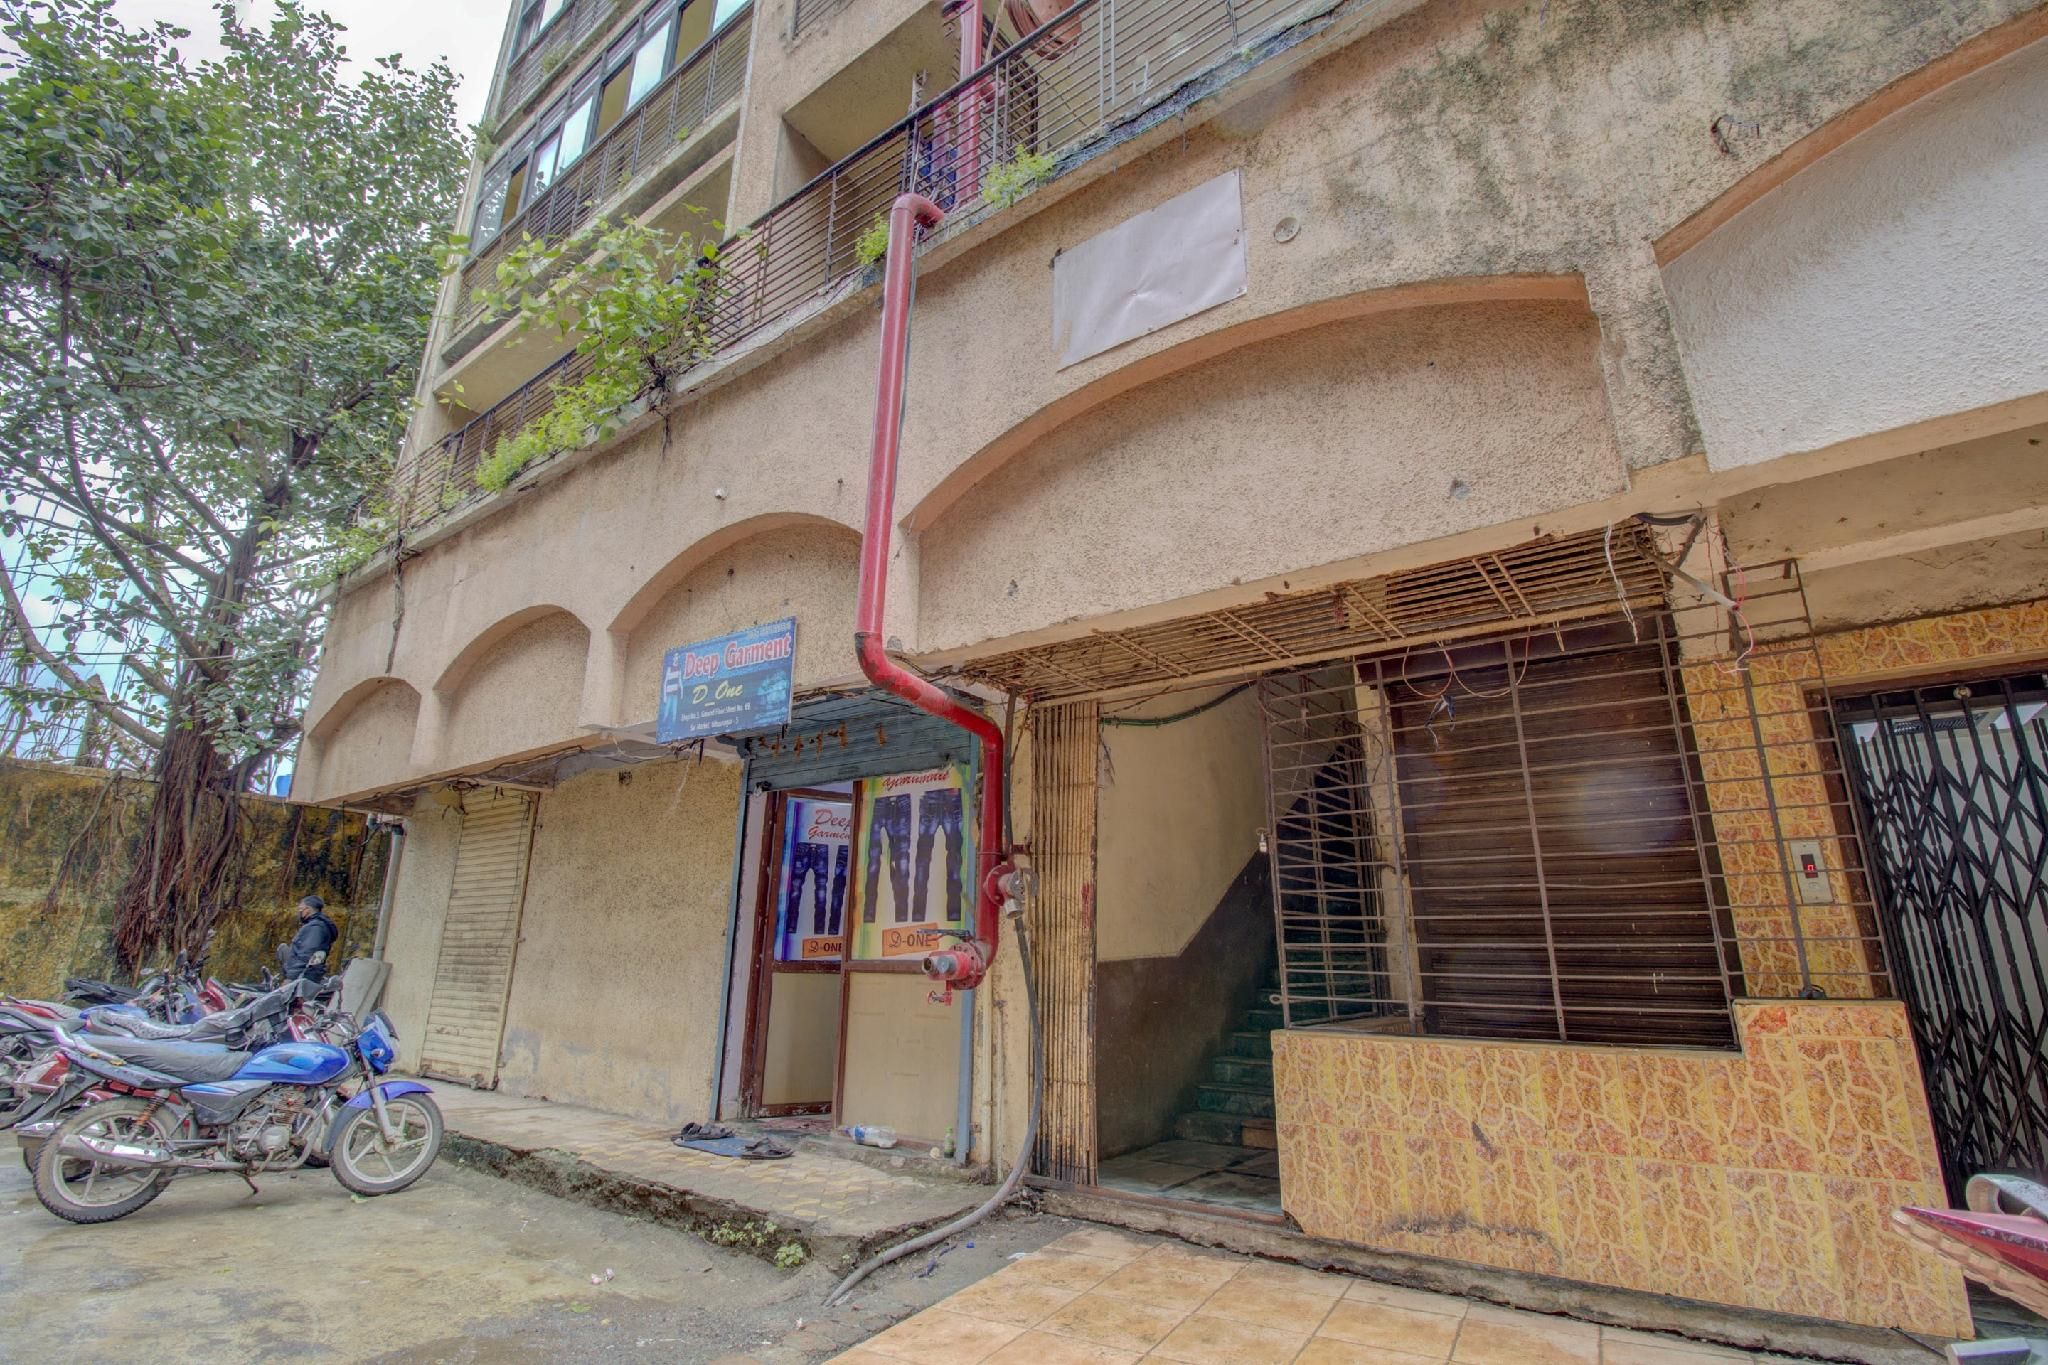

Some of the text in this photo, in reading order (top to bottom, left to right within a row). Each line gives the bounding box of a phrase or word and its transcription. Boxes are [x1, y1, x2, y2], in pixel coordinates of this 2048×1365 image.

[683, 633, 792, 679] Deep Garment
[888, 930, 932, 948] D-ONE
